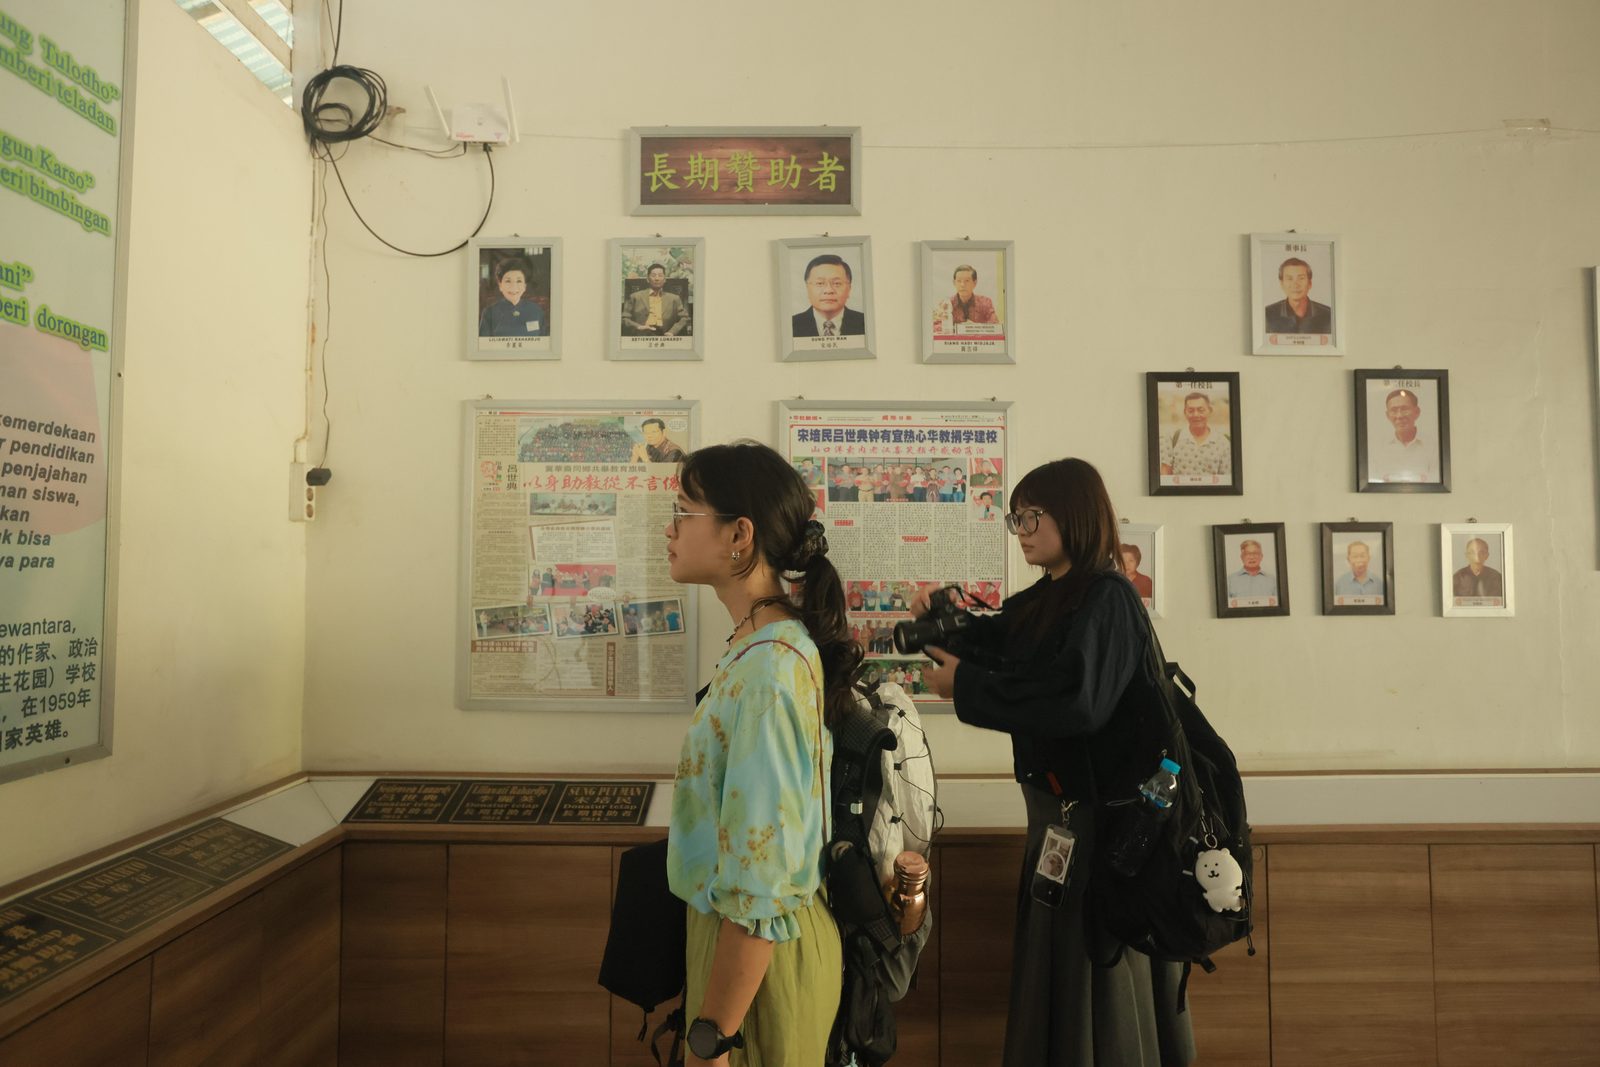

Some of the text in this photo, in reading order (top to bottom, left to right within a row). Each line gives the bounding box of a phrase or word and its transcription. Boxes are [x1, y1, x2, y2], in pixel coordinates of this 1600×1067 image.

[56, 81, 114, 132] teladan
[644, 151, 845, 193] 長期贊助者
[30, 174, 109, 232] bimbingan
[37, 307, 106, 347] dorongan
[9, 439, 95, 464] pendidikan
[1, 461, 88, 484] penjajahan
[32, 486, 79, 507] siswa,
[17, 529, 51, 546] bisa
[19, 556, 55, 572] para
[0, 719, 69, 753] 家英雄。
[609, 803, 638, 811] tetap
